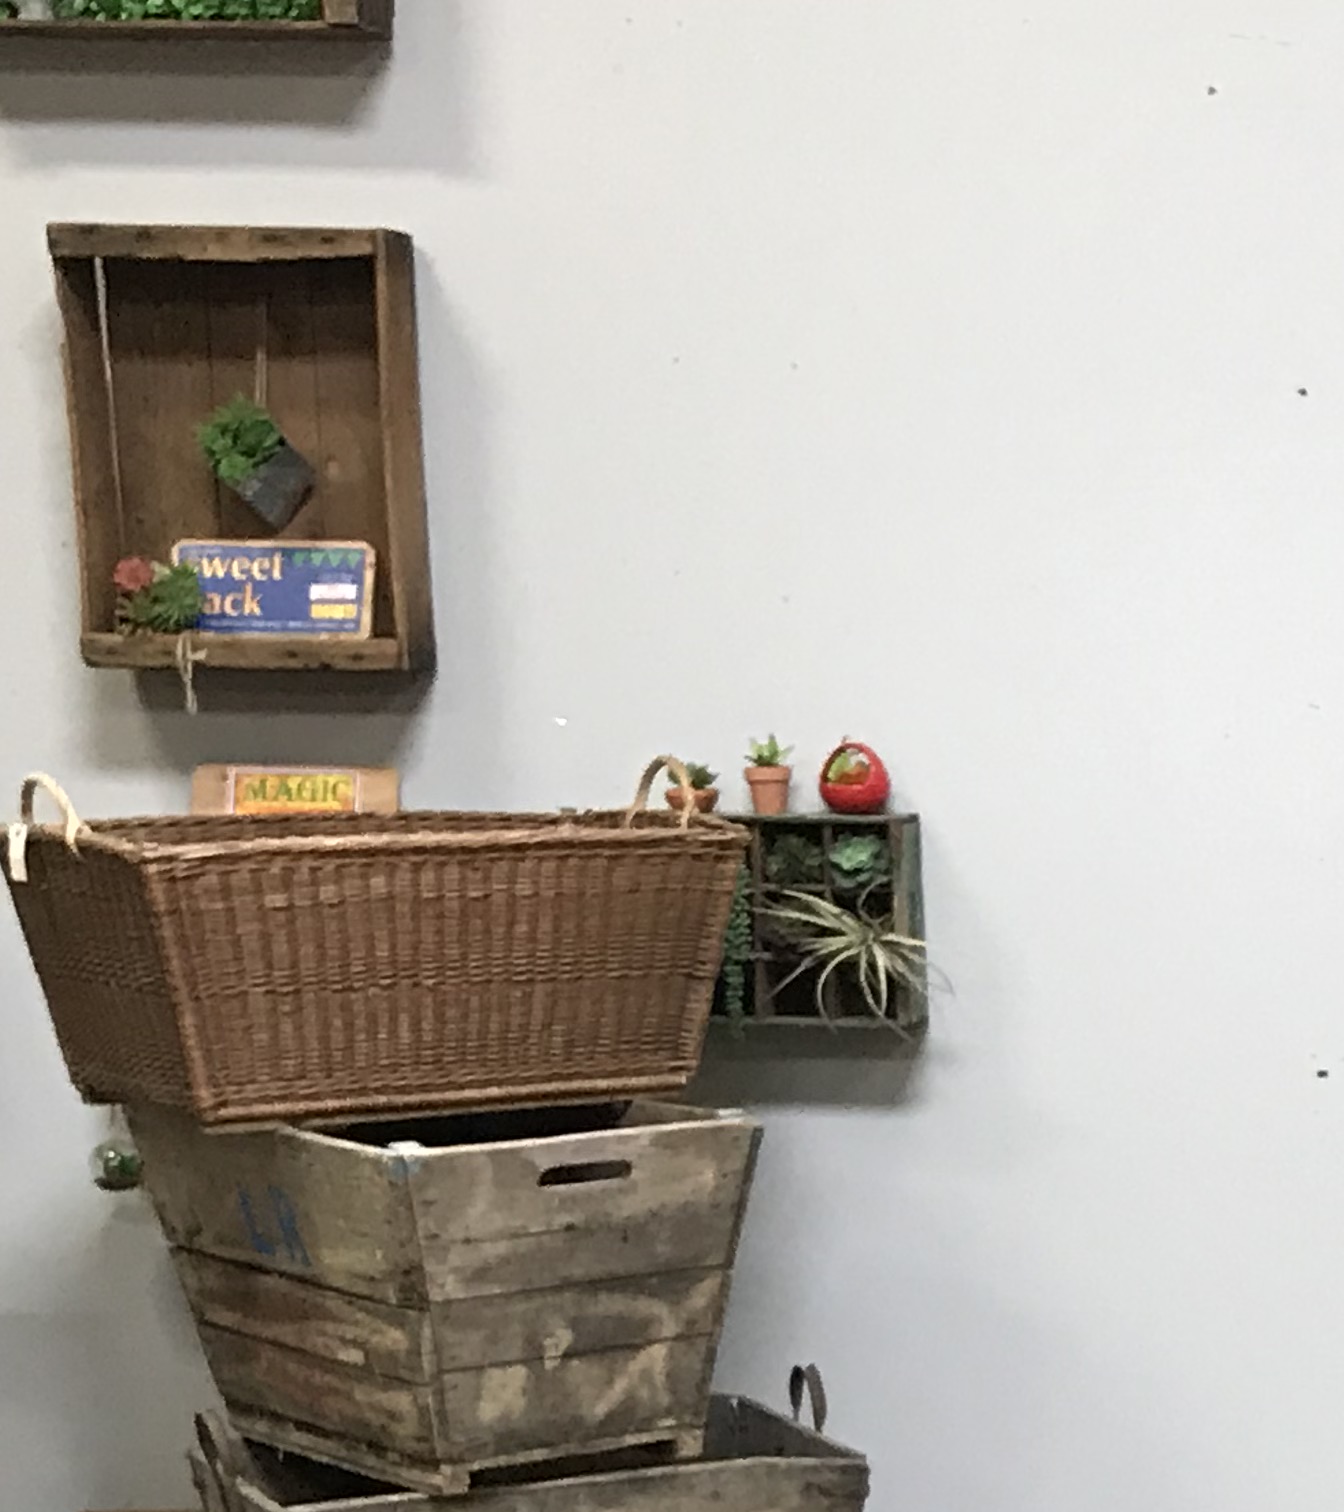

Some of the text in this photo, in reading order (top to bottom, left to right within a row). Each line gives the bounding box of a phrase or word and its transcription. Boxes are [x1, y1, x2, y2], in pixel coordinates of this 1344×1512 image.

[196, 551, 284, 581] weet
[199, 582, 263, 616] ack
[245, 778, 350, 802] MAGIC
